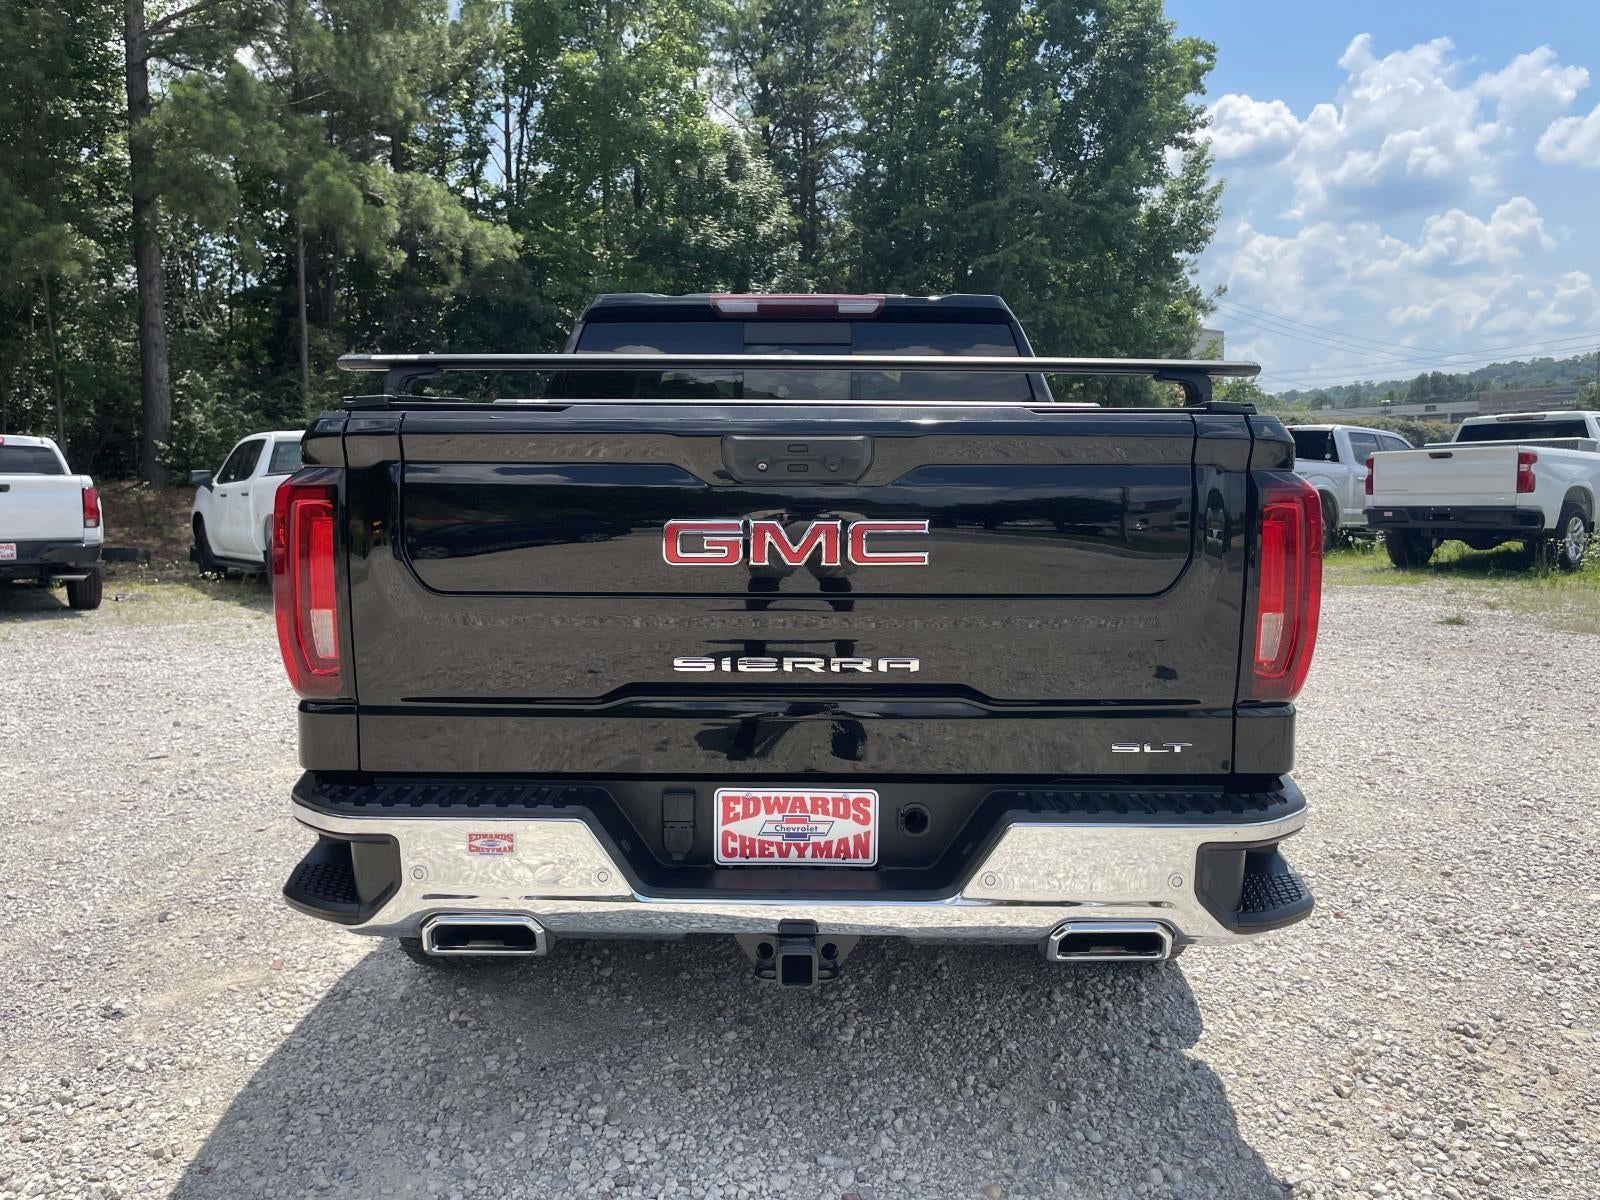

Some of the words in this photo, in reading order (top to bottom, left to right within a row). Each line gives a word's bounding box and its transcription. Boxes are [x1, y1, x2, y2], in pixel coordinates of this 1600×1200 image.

[662, 518, 930, 566] GMC
[673, 656, 920, 673] SIERRA
[1111, 742, 1193, 753] SLT
[721, 796, 871, 826] EDWARDS
[774, 825, 818, 833] Chevrolet
[468, 833, 514, 843] EDWARDS
[721, 830, 871, 860] CHEVYMAN
[468, 844, 514, 853] CHEVYMAN
